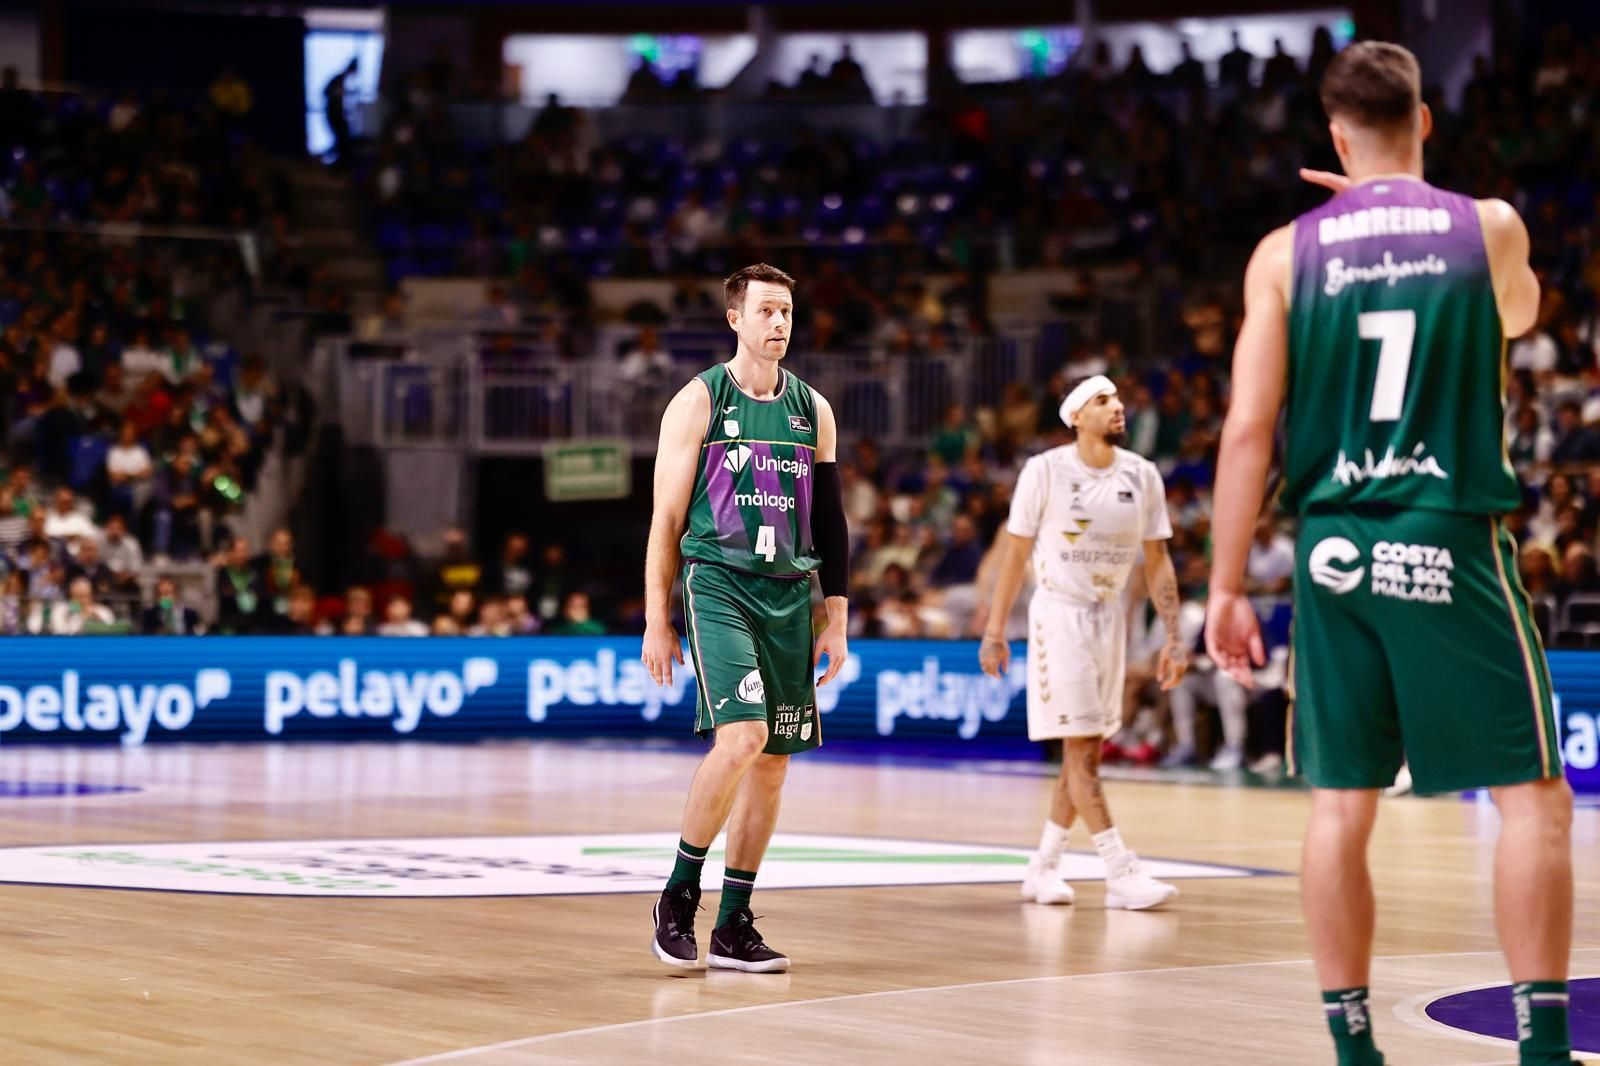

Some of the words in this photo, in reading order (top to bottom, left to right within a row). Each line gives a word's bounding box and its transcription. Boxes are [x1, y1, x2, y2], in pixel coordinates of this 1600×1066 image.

[1319, 206, 1451, 245] BARREIRO
[1357, 309, 1416, 422] 7
[754, 454, 809, 479] Unicaja
[734, 487, 795, 512] málaga
[754, 525, 776, 562] 4
[1371, 541, 1454, 570] COSTA
[1371, 561, 1411, 583] DEL
[1411, 565, 1454, 588] SOL
[264, 657, 464, 734] pelayo
[776, 702, 795, 712] sabor
[876, 655, 1010, 740] pelayo
